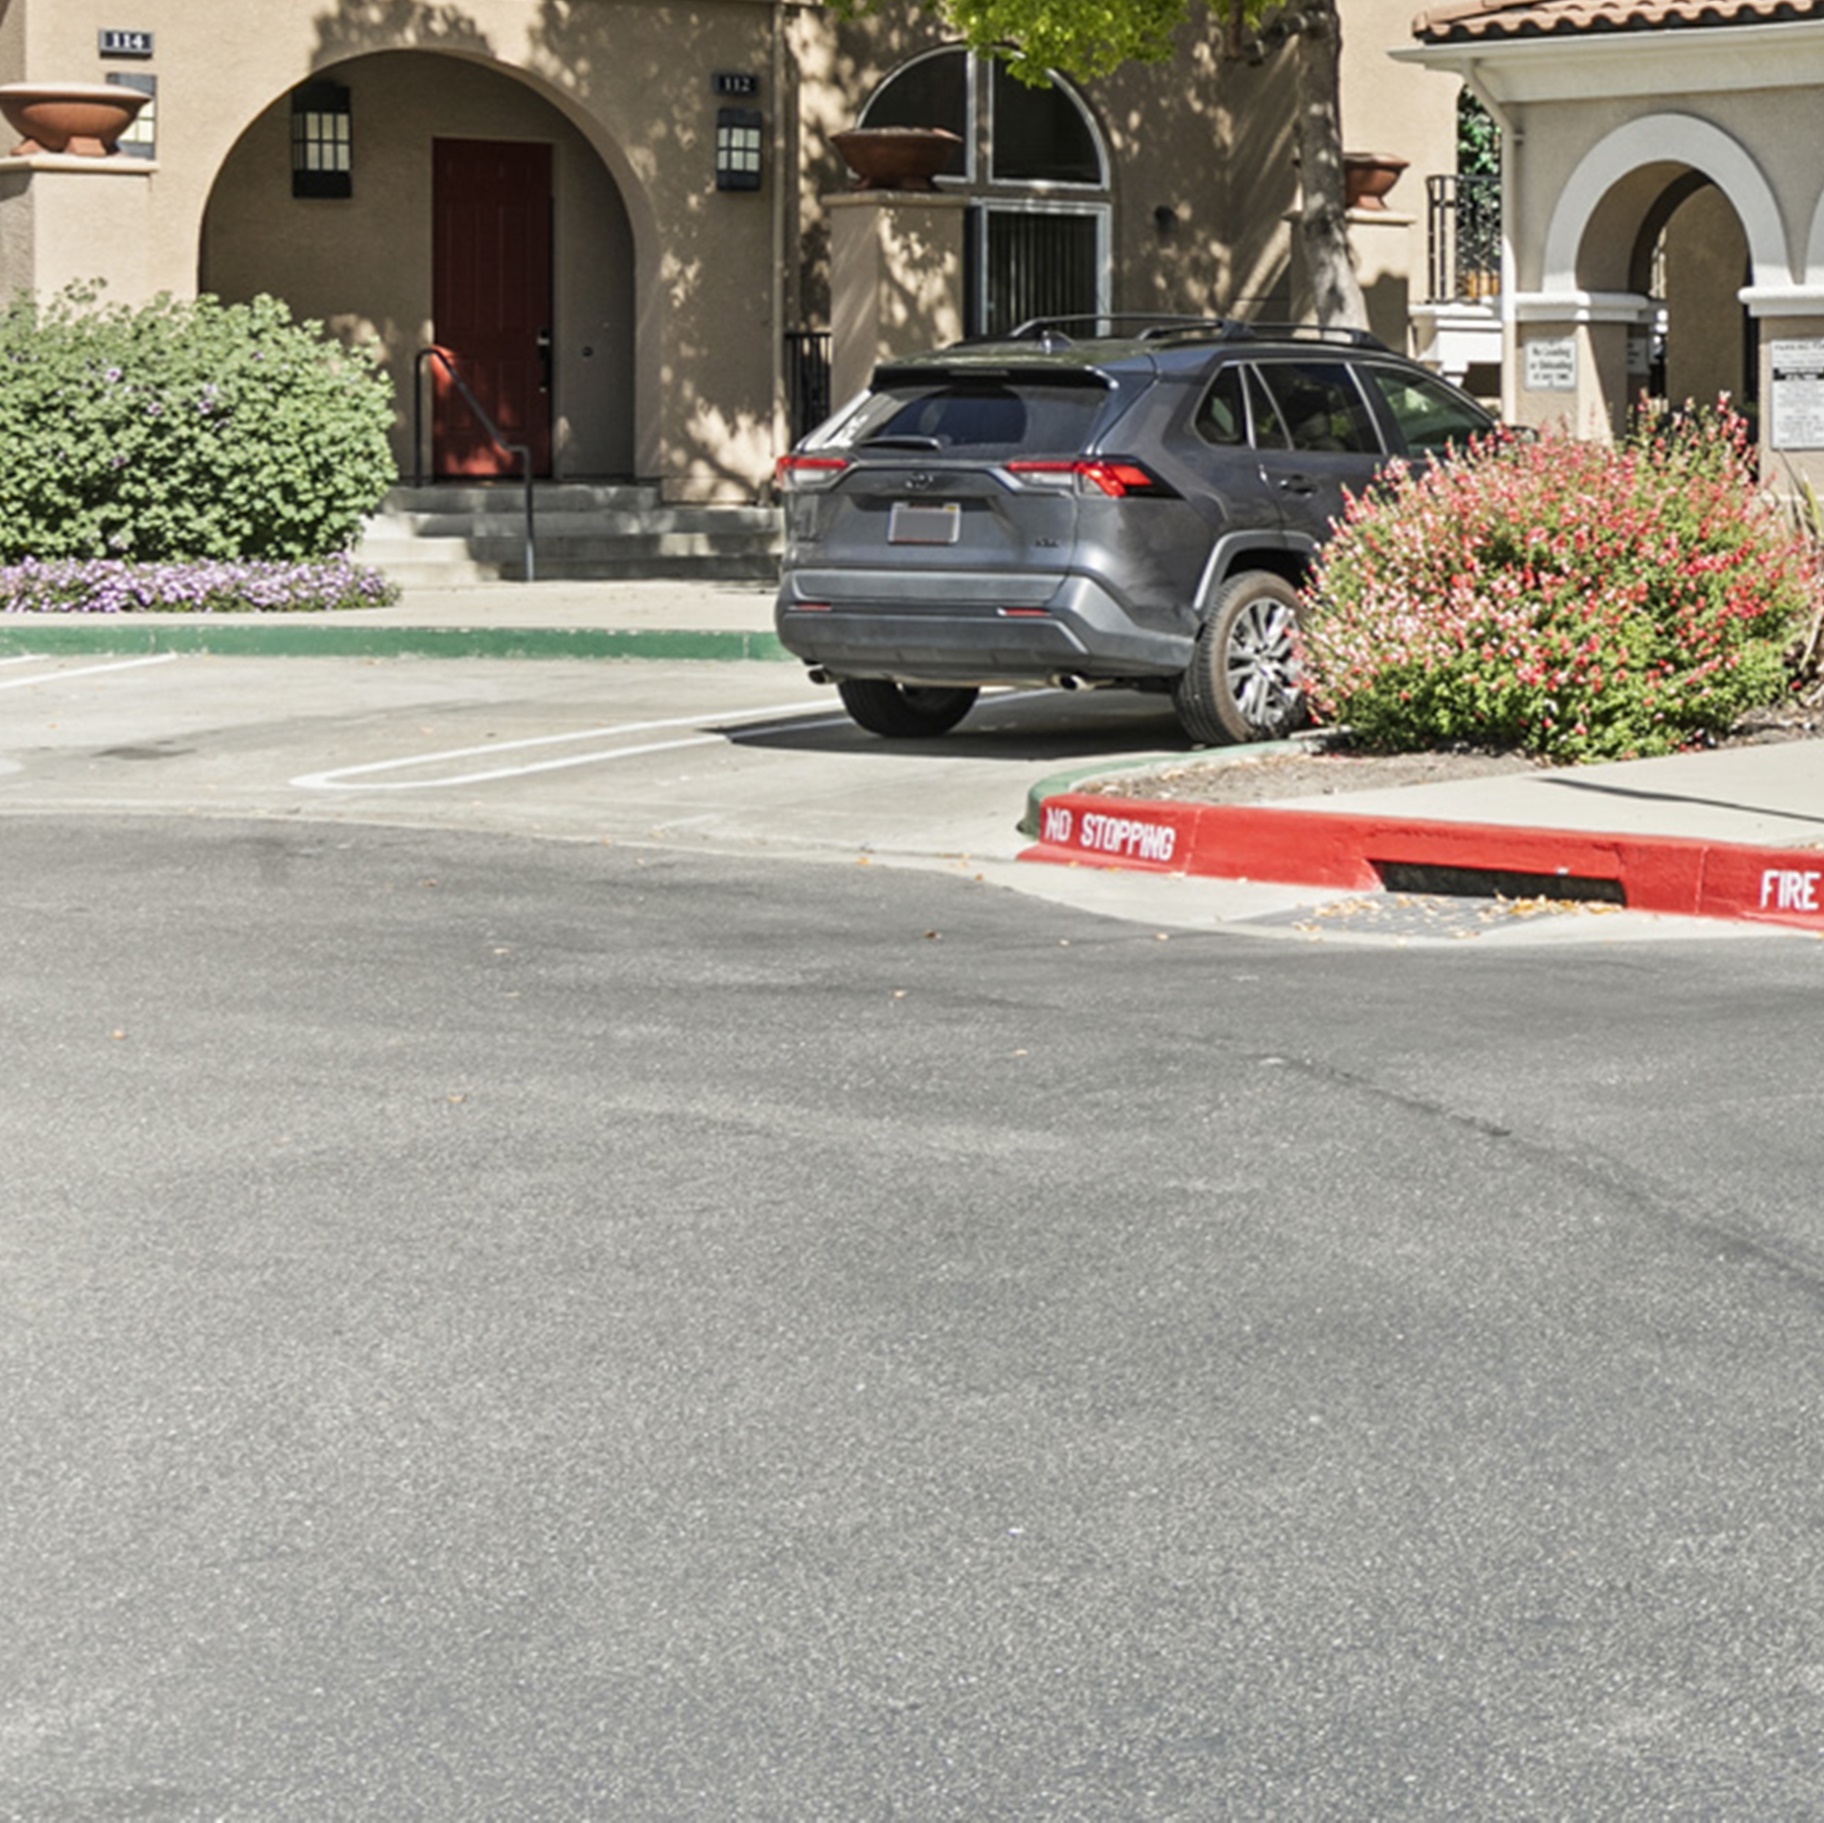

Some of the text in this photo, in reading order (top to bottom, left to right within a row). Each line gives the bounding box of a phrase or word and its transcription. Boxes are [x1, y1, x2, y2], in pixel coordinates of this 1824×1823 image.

[112, 33, 145, 49] 114
[725, 77, 750, 92] 112
[1045, 807, 1176, 862] NO STOPPING
[1760, 869, 1821, 911] FIRE
